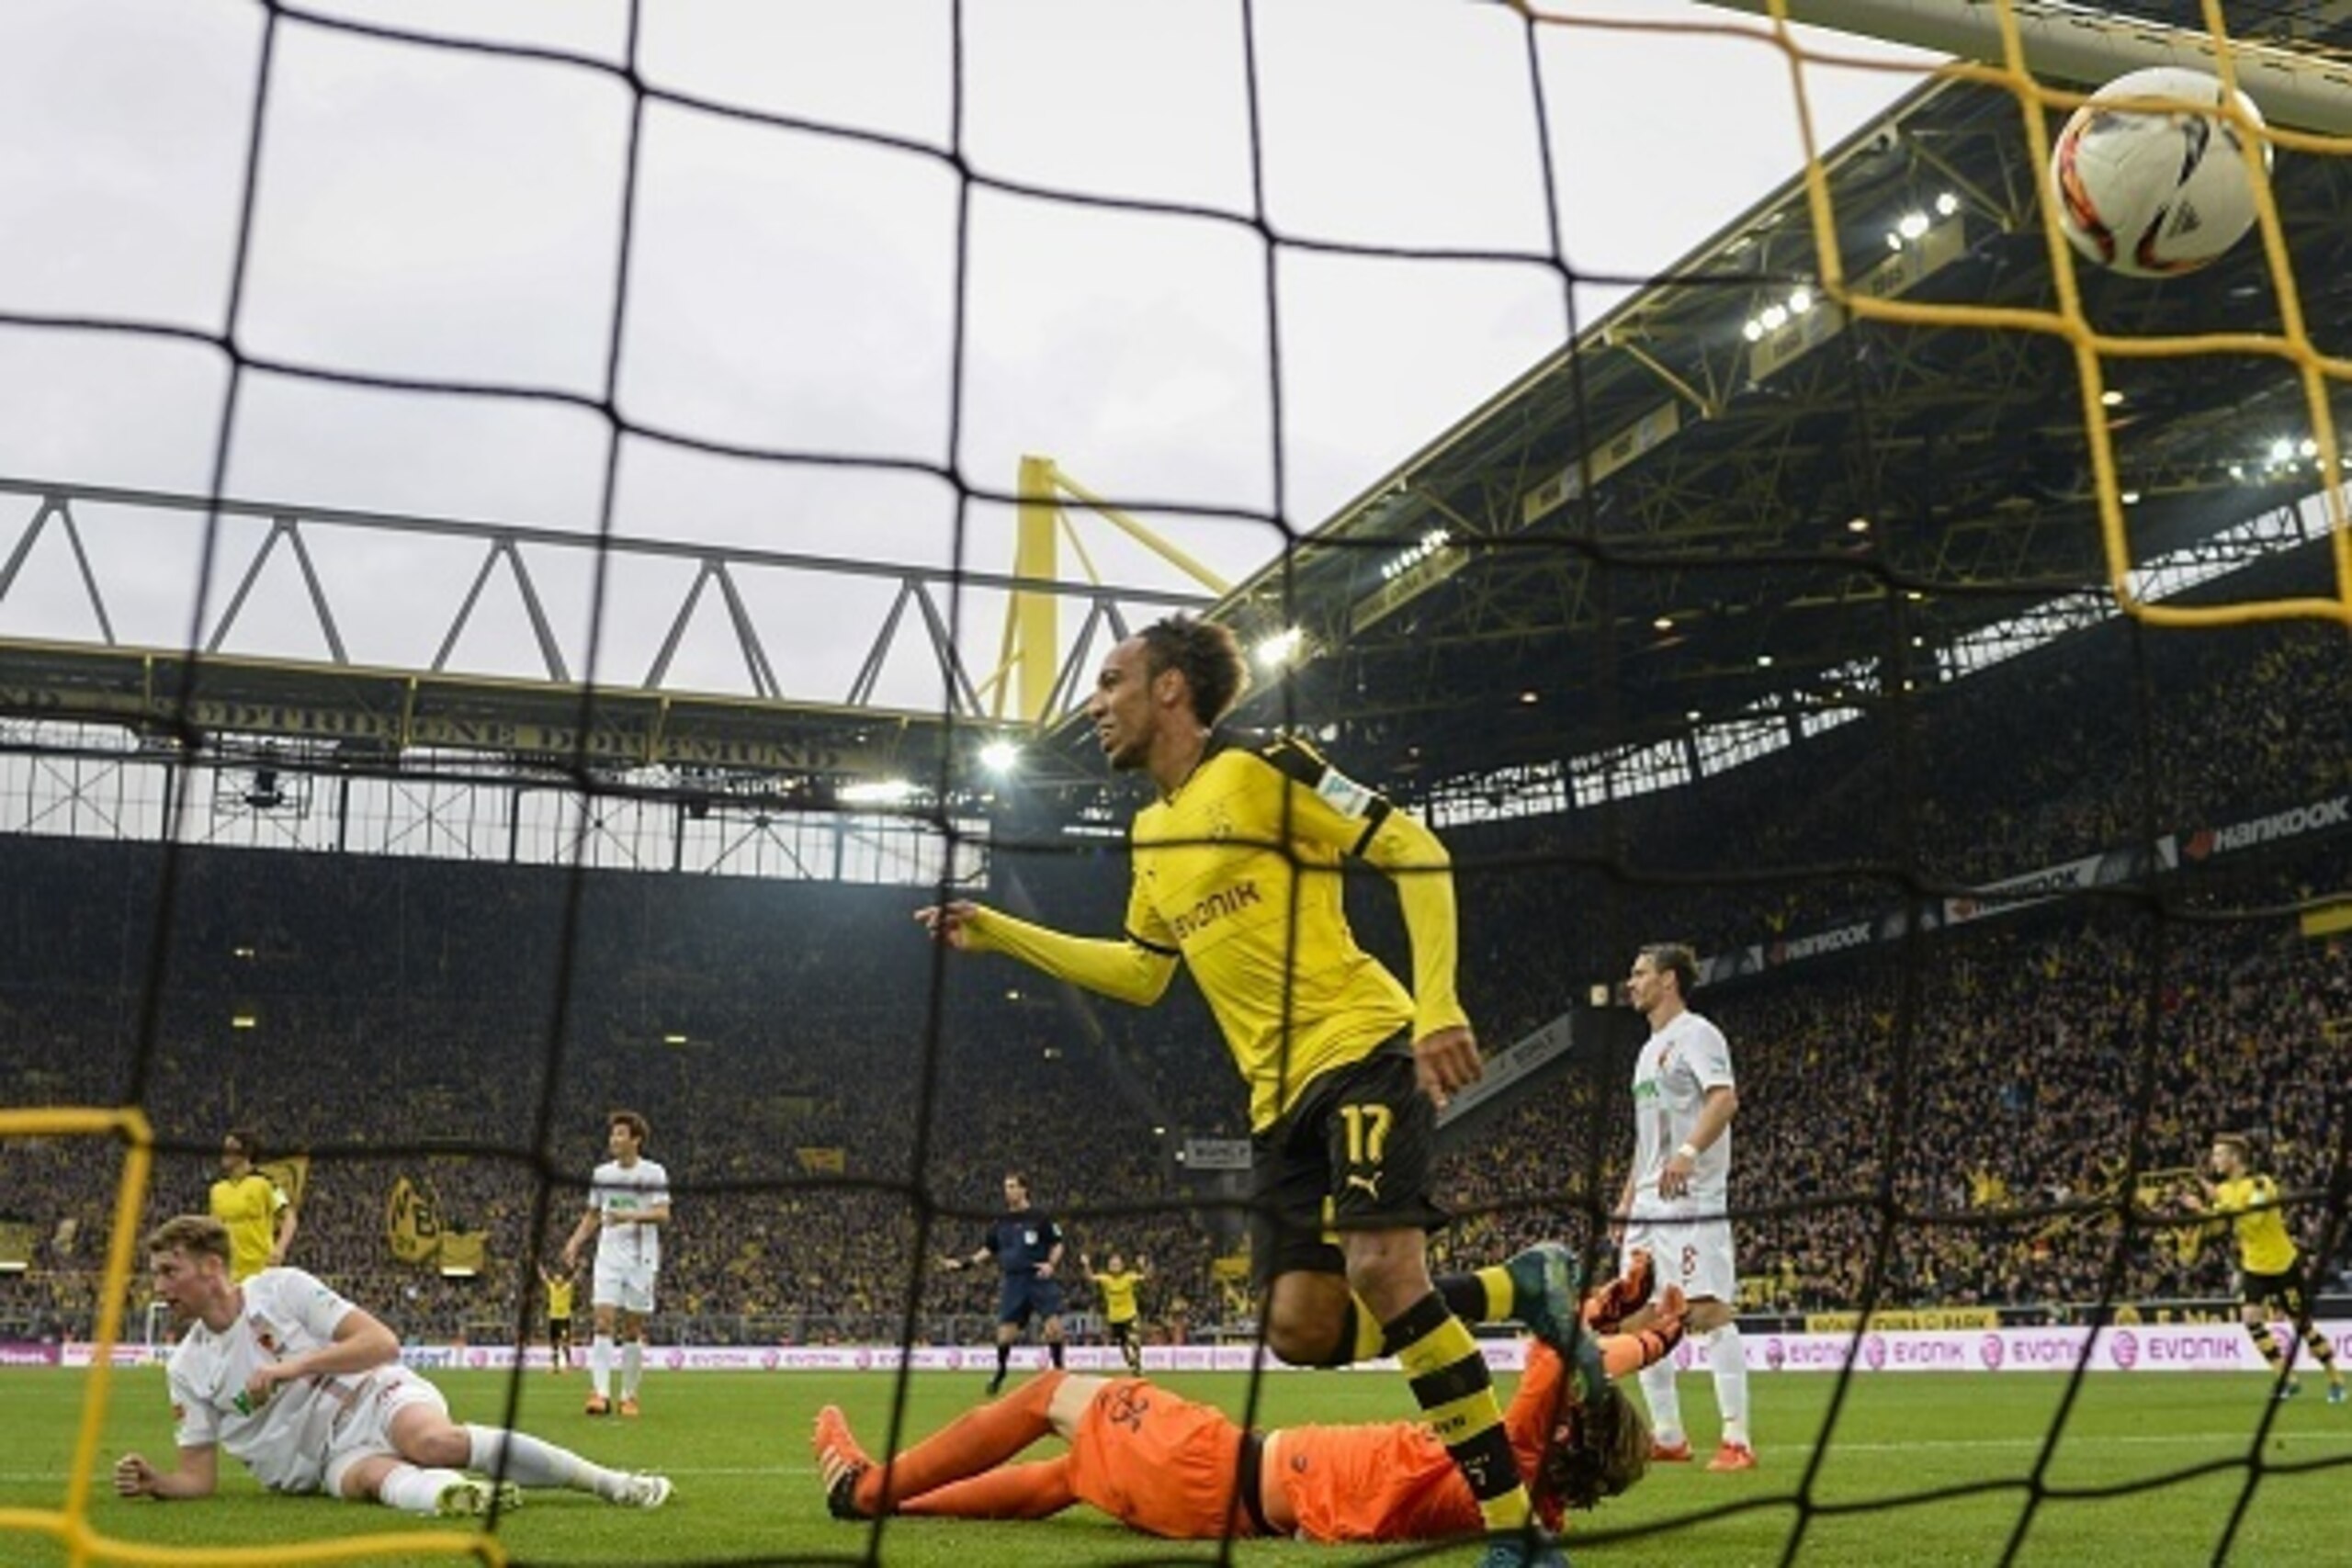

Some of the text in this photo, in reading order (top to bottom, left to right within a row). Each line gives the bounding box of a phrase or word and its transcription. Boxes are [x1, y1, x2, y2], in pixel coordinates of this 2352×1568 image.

[1340, 1104, 1392, 1164] 17
[1894, 1341, 1964, 1362] EVONIK
[2148, 1337, 2242, 1360] EVONIK
